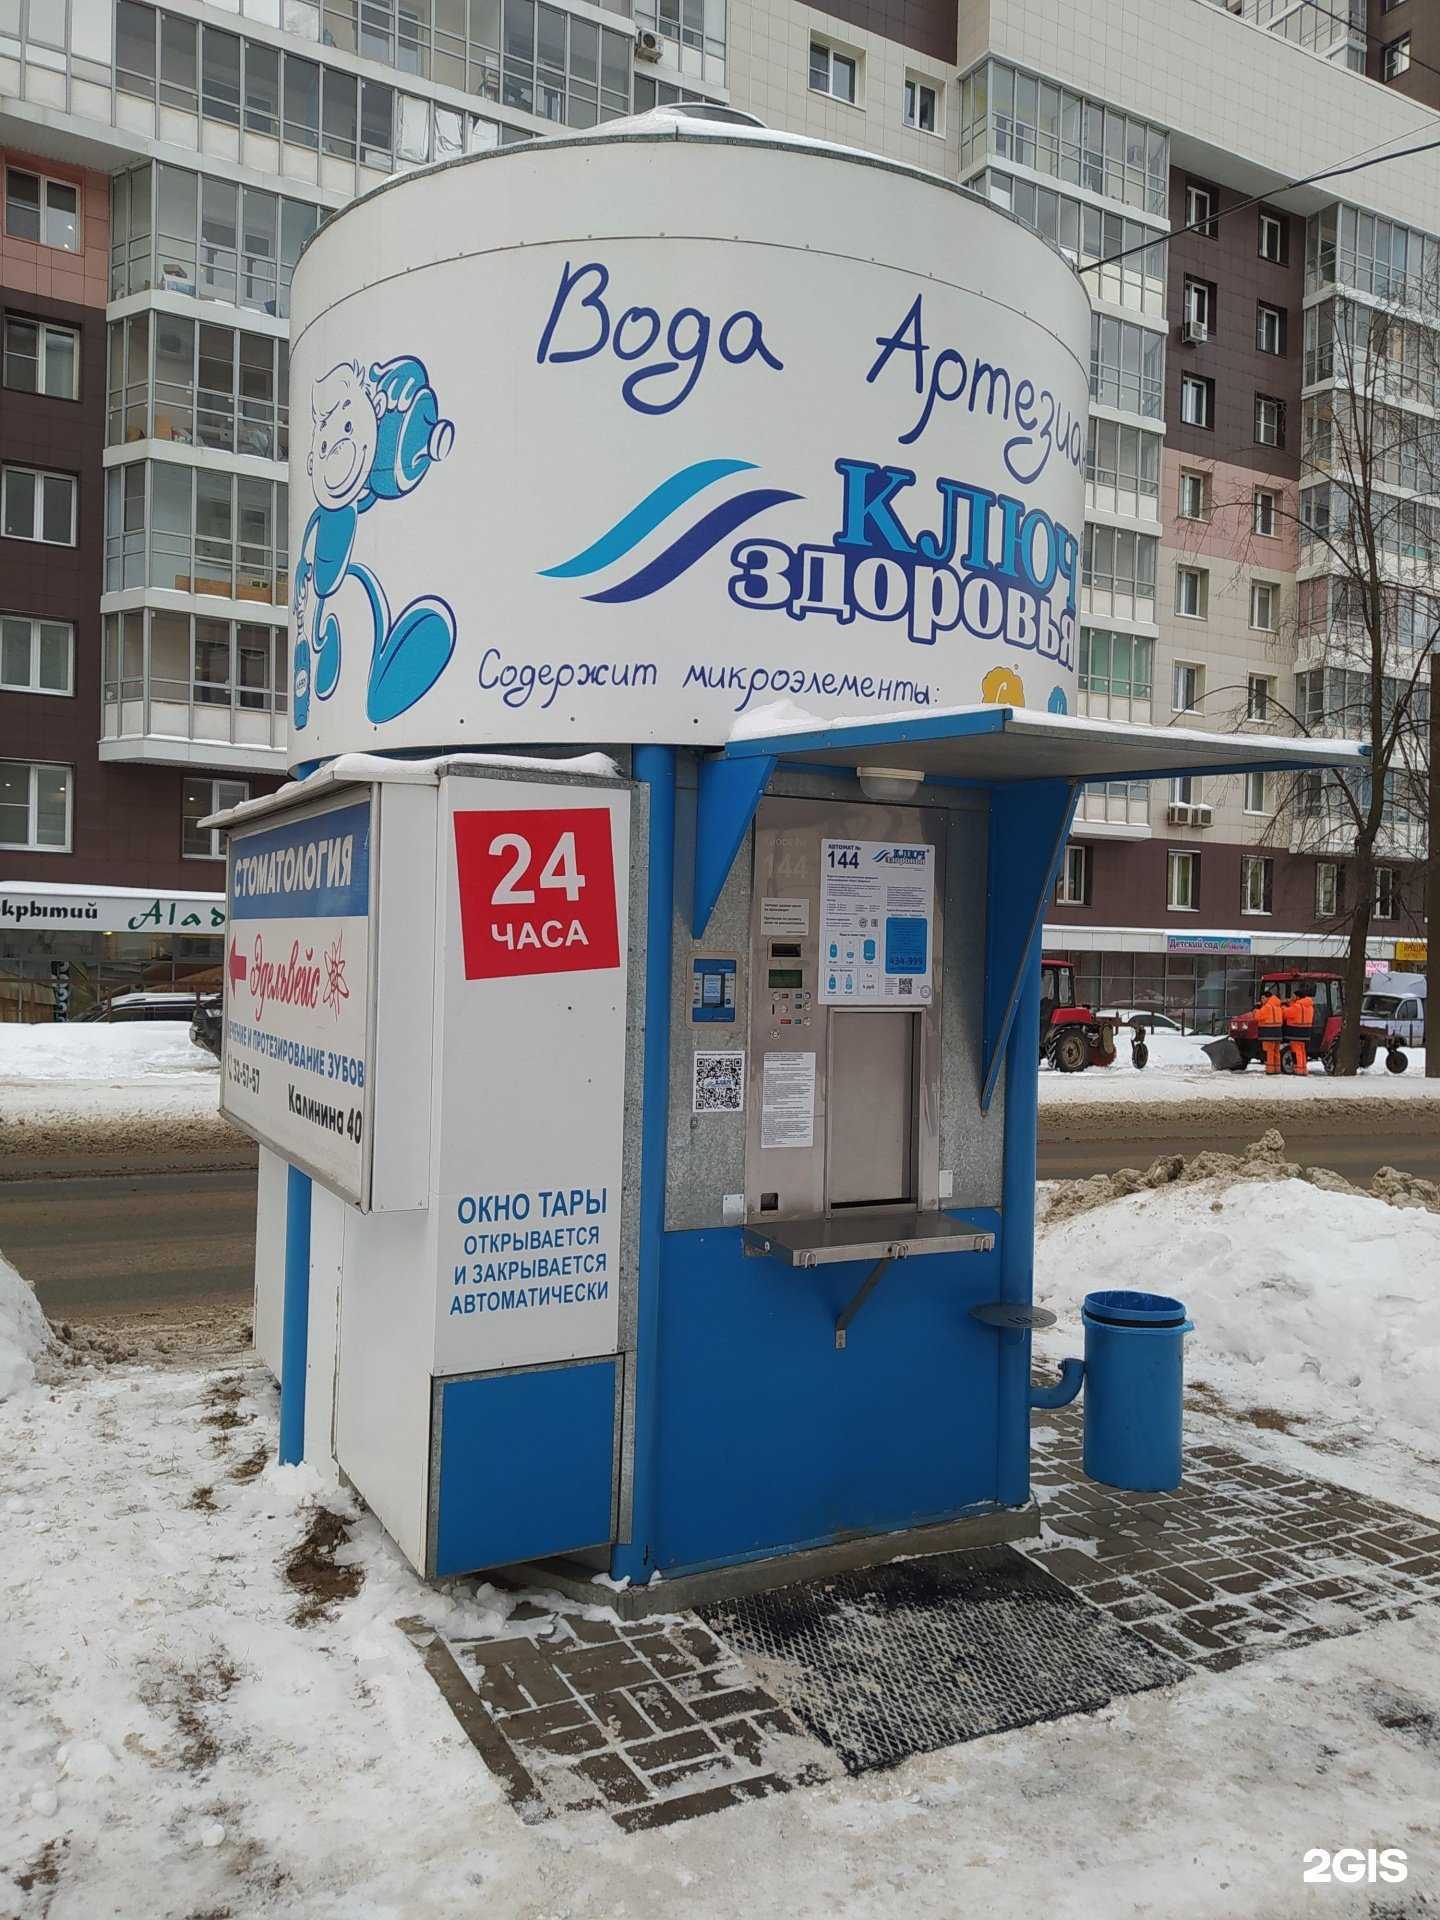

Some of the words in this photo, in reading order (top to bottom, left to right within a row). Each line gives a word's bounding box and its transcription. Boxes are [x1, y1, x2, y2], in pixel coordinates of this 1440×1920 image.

[537, 261, 784, 415] Вода
[479, 648, 657, 707] Содержит
[682, 664, 940, 711] микроэлементы:
[234, 834, 353, 897] СТОМАТОЛОГИЯ
[487, 831, 586, 905] 24
[827, 850, 860, 869] 144
[0, 899, 98, 923] крытий
[491, 919, 589, 951] ЧАСА
[250, 933, 321, 1022] Эдельвейс
[253, 1029, 326, 1077] ПРОТЕЗИРОВАНИЕ
[328, 1051, 365, 1089] ЗУБОВ
[288, 1082, 345, 1136] Калинина
[346, 1107, 363, 1145] 40
[457, 1193, 531, 1225] ОКНО
[538, 1187, 607, 1218] ТАРЫ
[463, 1225, 600, 1256] ОТКРЫВАЕТСЯ
[454, 1265, 466, 1286] И
[472, 1253, 607, 1284] ЗАКРЫВАЕТСЯ
[449, 1281, 609, 1316] АВТОМАТИЧЕСКИ
